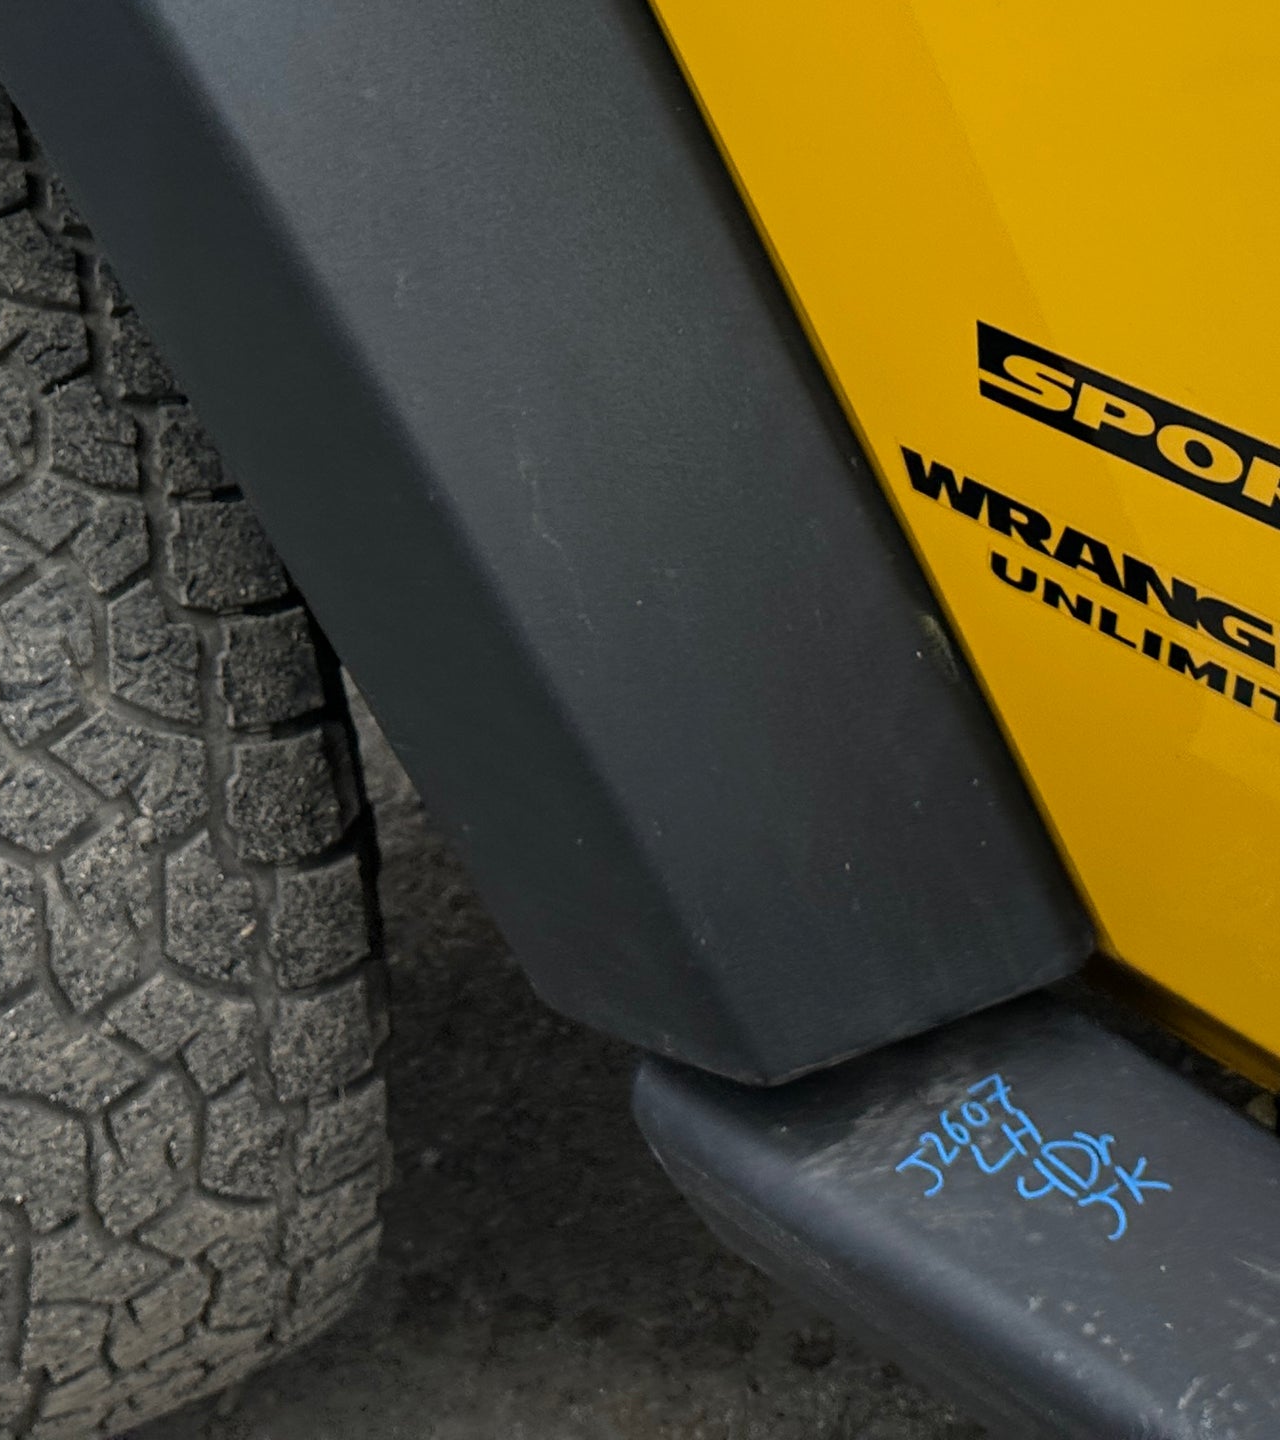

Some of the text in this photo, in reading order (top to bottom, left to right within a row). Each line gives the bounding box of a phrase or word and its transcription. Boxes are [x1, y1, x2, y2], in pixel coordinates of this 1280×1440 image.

[895, 1073, 1011, 1197] J2607
[971, 1109, 1042, 1174] LH
[1078, 1157, 1172, 1241] JK
